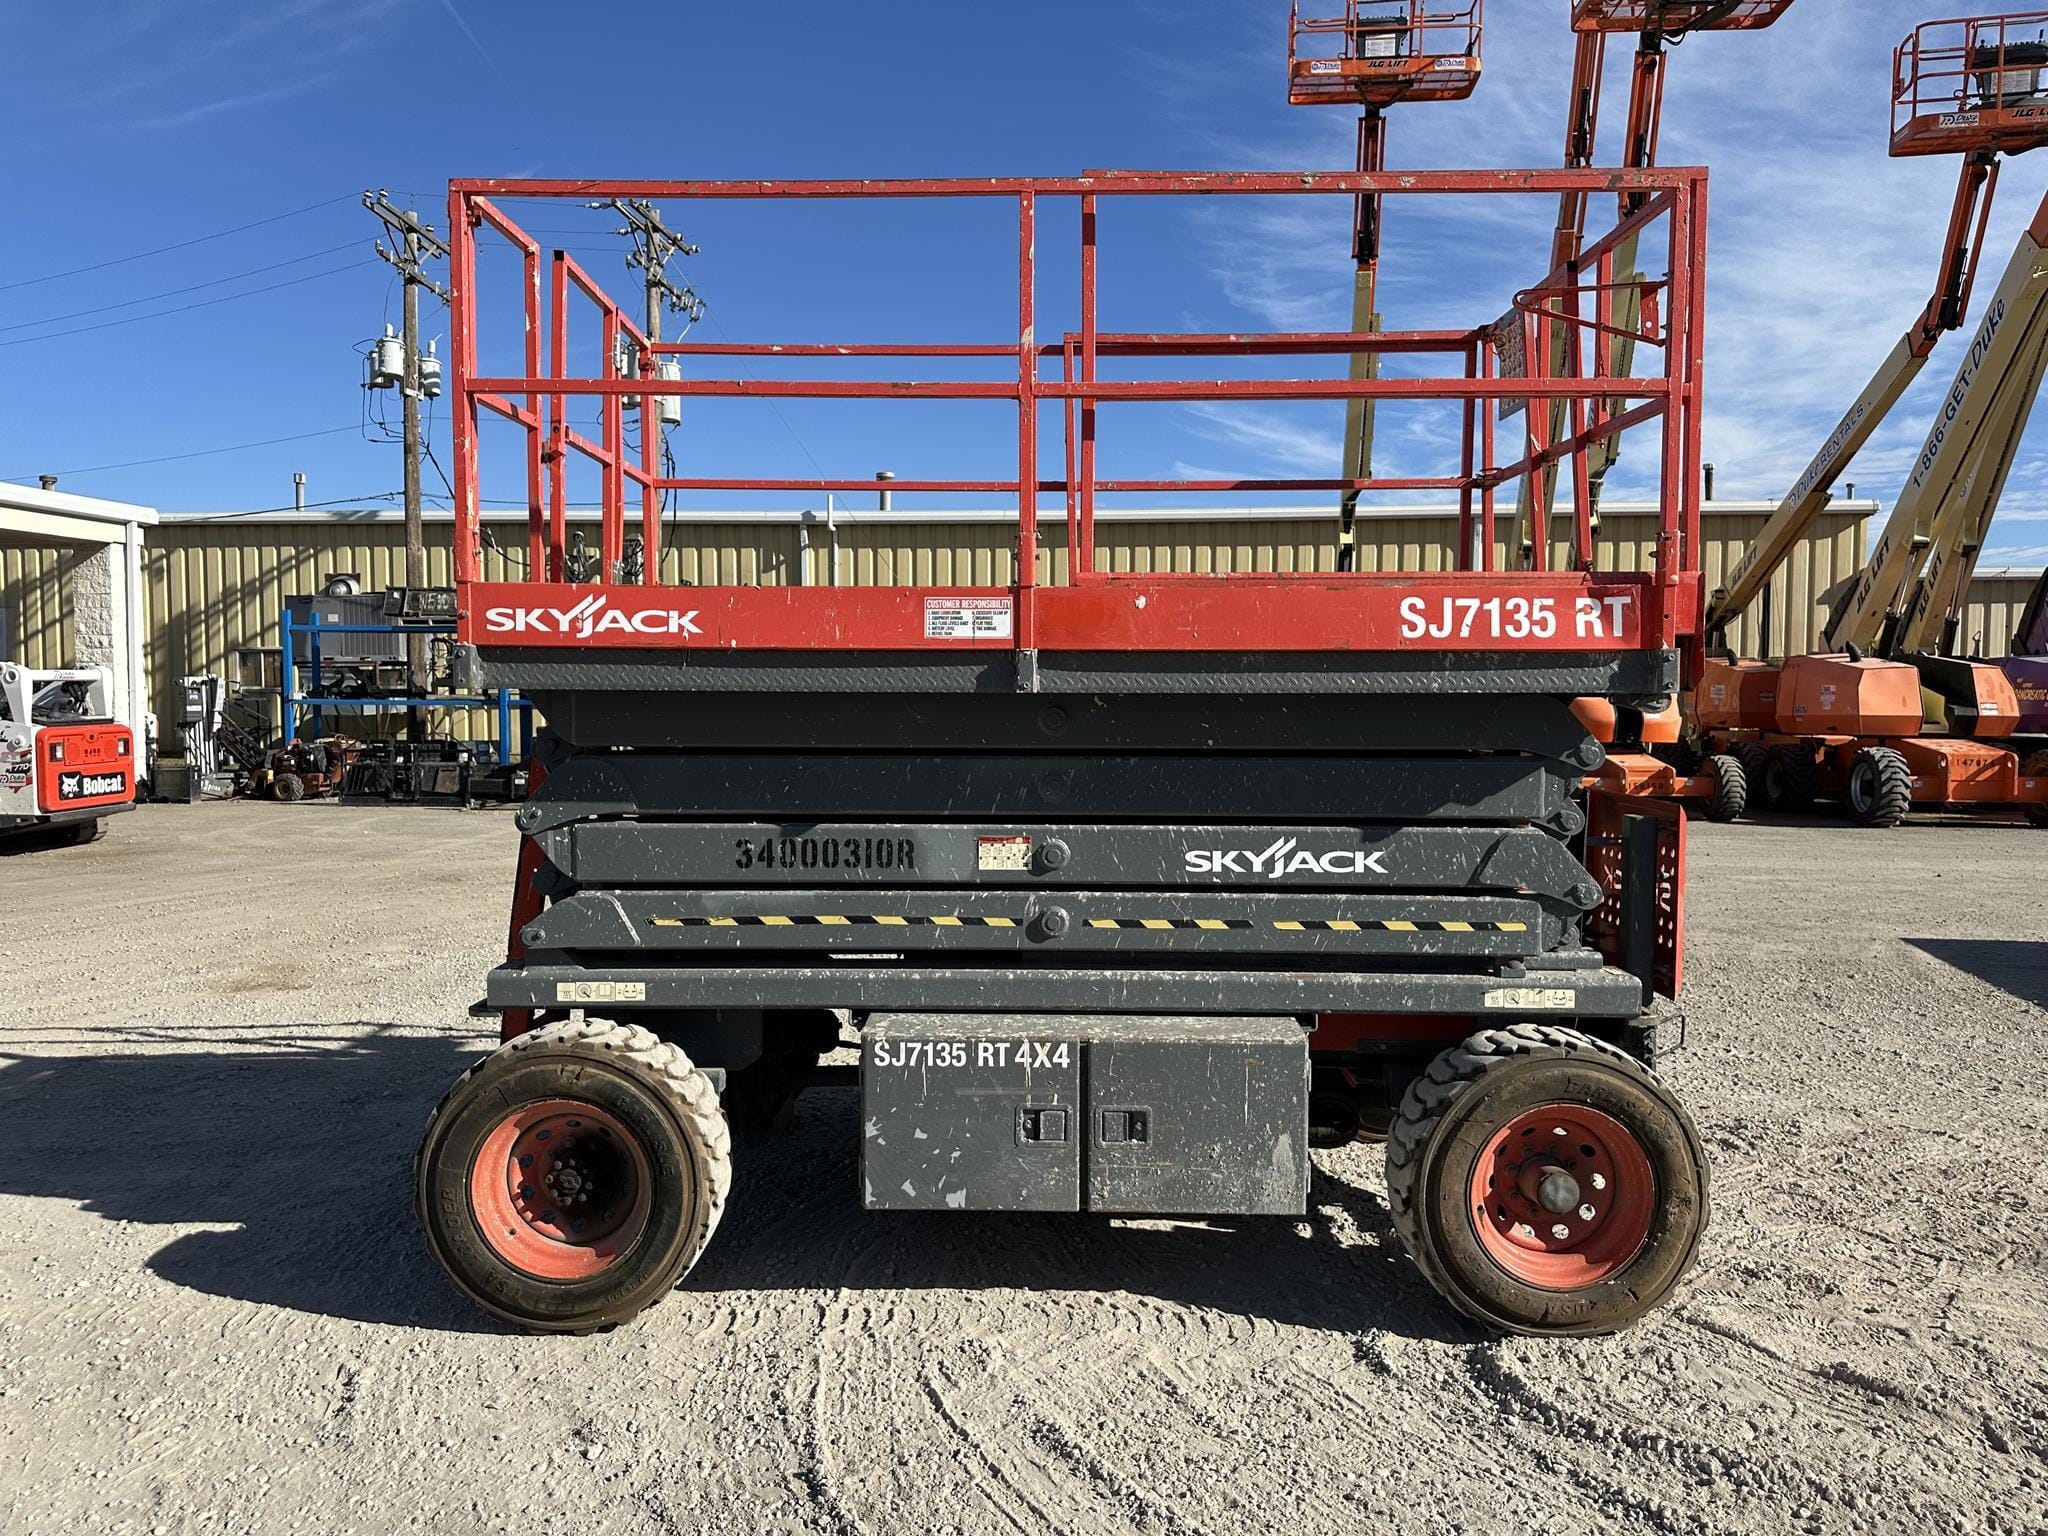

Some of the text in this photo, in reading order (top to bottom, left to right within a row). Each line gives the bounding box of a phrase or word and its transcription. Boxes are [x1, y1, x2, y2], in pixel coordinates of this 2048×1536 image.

[2012, 108, 2035, 118] JLG
[1856, 535, 1889, 614] JLG LIFT
[1918, 551, 1942, 622] JLG LIFT
[485, 593, 704, 639] SKYJACK
[926, 599, 1010, 609] CUSTOMER RESPONSIBILITY
[1400, 596, 1632, 638] SJ7135 RT
[83, 774, 122, 795] Bobcat
[735, 838, 915, 869] 34000310R
[1184, 836, 1389, 879] SKYJACK
[873, 1042, 1071, 1068] SJ7135 RT 4X4
